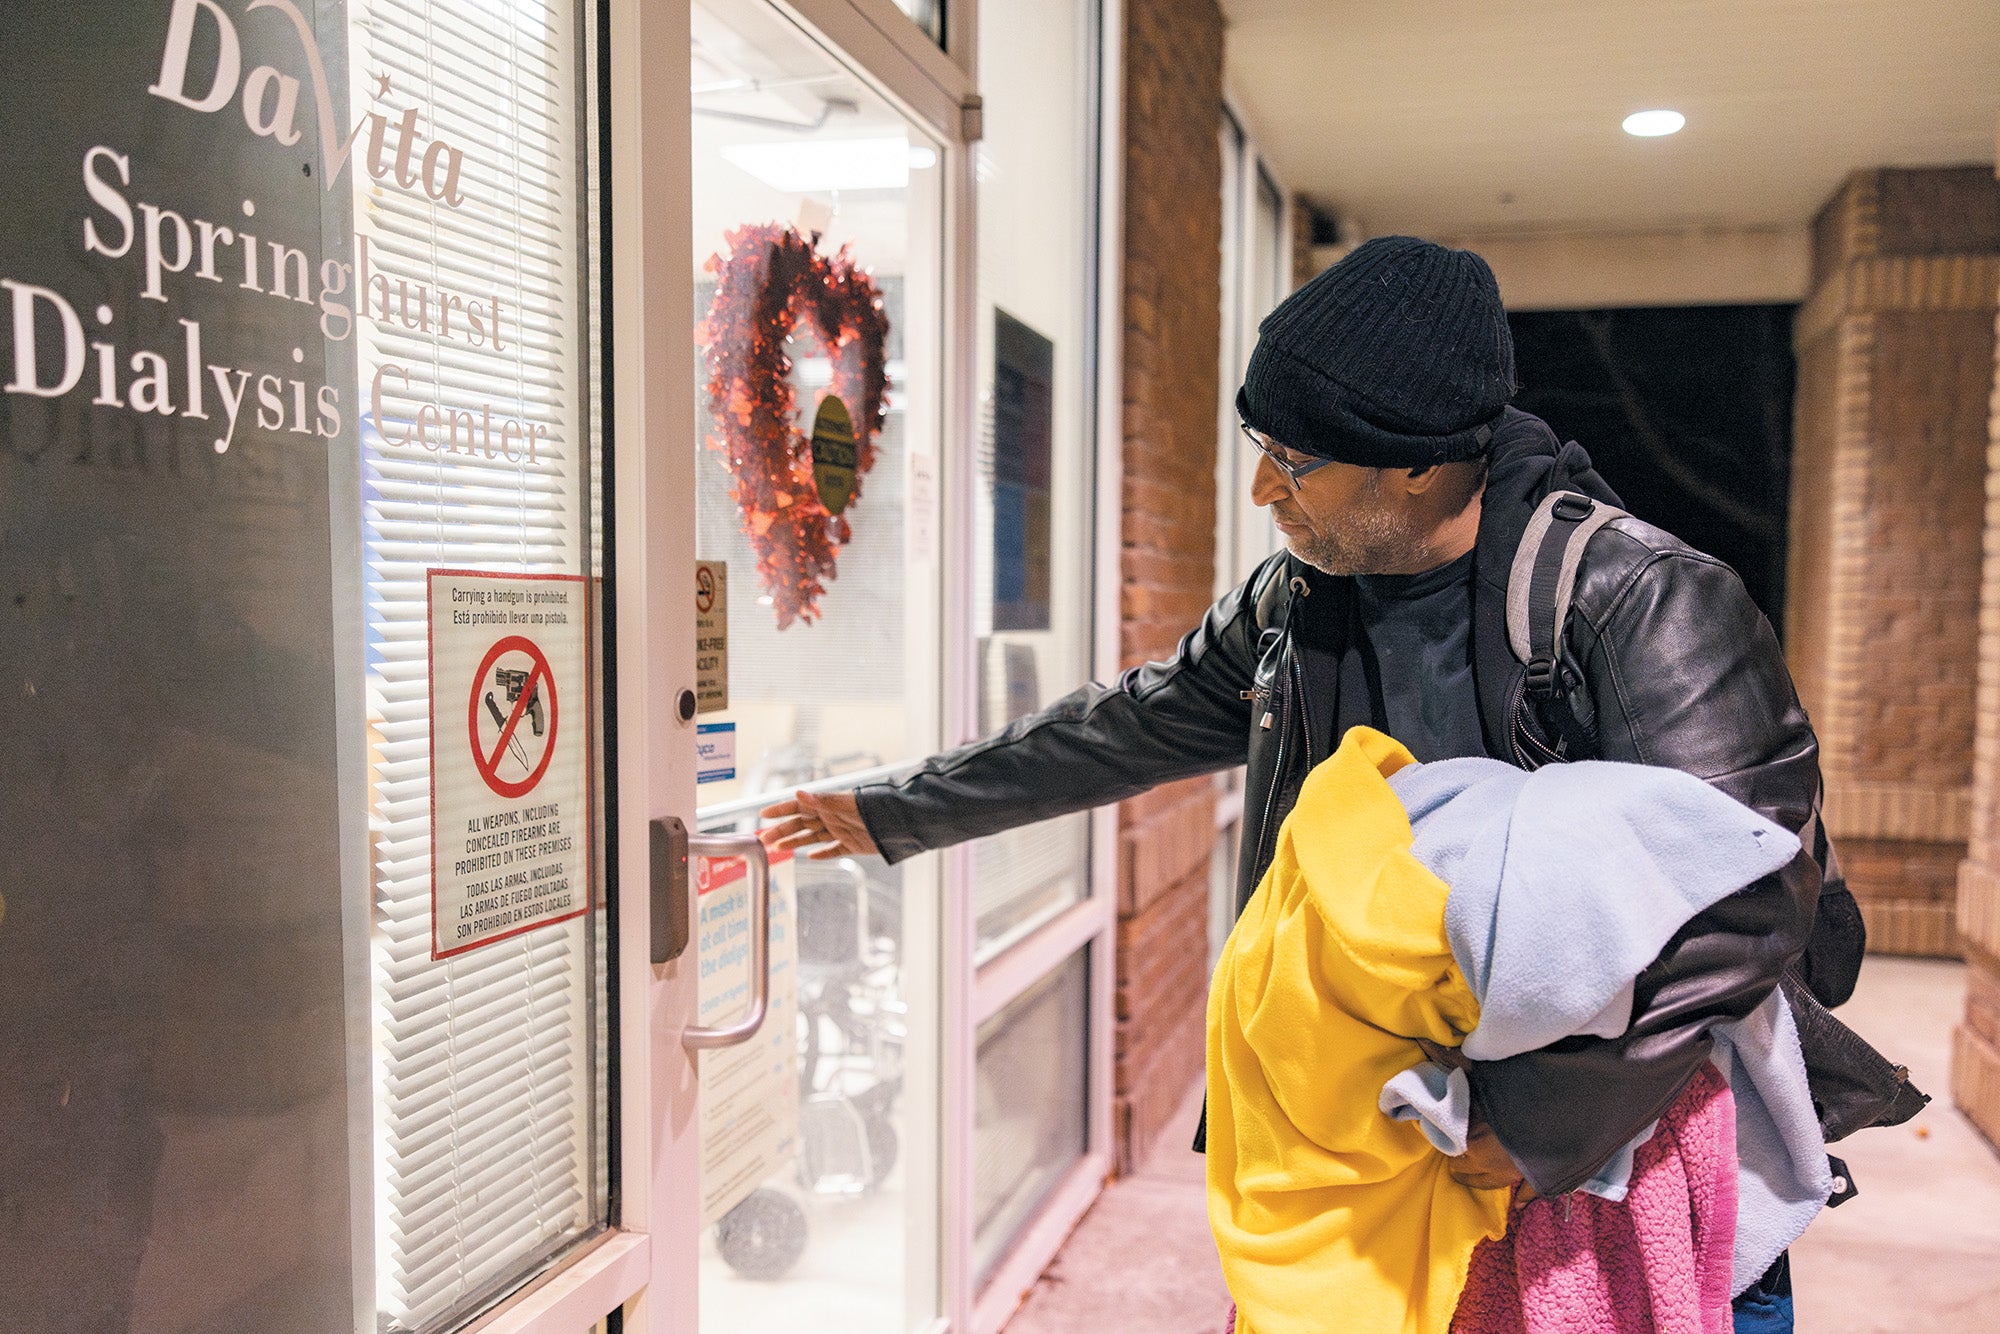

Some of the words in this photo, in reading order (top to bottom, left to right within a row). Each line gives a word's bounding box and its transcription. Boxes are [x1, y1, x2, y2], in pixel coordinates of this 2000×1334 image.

[148, 0, 465, 208] DaVita
[83, 145, 507, 352] Springhurst
[0, 278, 341, 454] Dialysis
[370, 363, 548, 466] Center
[452, 587, 486, 606] Carrying
[487, 591, 492, 602] a
[493, 589, 525, 606] handgun
[526, 590, 532, 603] is
[534, 590, 569, 605] prohibited.
[453, 609, 470, 625] Está
[472, 610, 508, 627] prohibido
[509, 611, 530, 624] llevar
[530, 613, 543, 624] una
[544, 611, 568, 626] pistola.
[466, 832, 510, 854] CONCEALED
[511, 824, 546, 844] FIREARMS
[548, 821, 561, 836] ARE
[468, 818, 481, 834] ALL
[483, 811, 520, 831] WEAPONS,
[522, 803, 559, 823] INCLUDING
[455, 853, 501, 877] PROHIBITED
[503, 851, 514, 865] ON
[515, 845, 537, 862] THESE
[538, 836, 572, 856] PREMISES
[460, 903, 473, 919] LAS
[475, 896, 499, 914] ARMAS
[500, 893, 509, 908] DE
[511, 887, 532, 905] FUEGO
[534, 878, 568, 898] OCULTADAS
[466, 880, 489, 899] TODAS
[490, 877, 503, 892] LAS
[504, 871, 529, 888] ARMAS,
[530, 862, 563, 882] INCLUIDAS
[457, 921, 472, 939] SON
[473, 911, 512, 934] PROHIBIDO
[513, 907, 523, 922] EN
[523, 901, 544, 919] ESTOS
[544, 894, 571, 913] LOCALES
